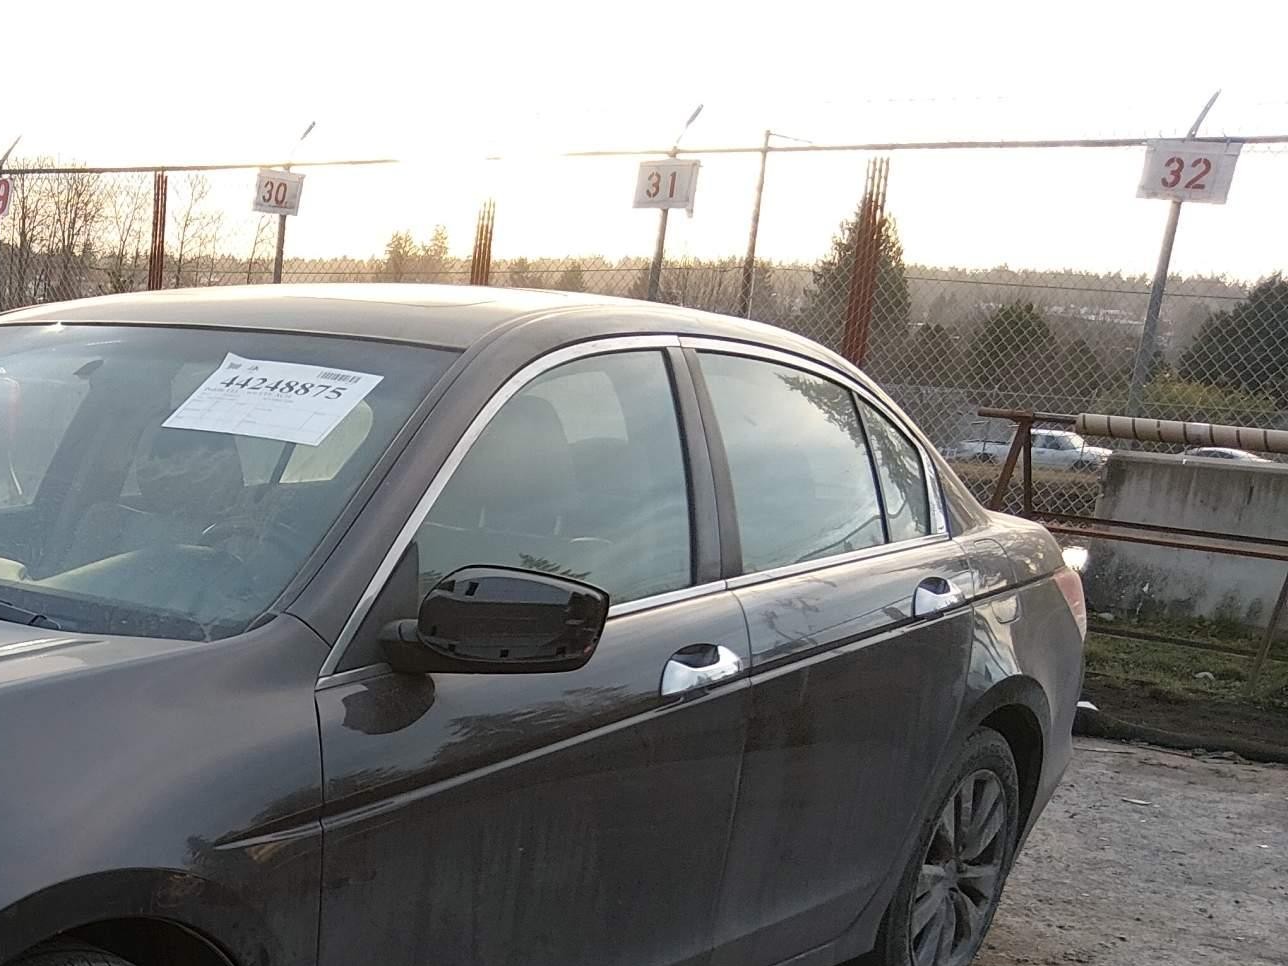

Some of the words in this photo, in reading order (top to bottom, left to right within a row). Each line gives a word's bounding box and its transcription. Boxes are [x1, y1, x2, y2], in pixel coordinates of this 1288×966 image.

[645, 171, 678, 199] 31
[1160, 156, 1212, 190] 32
[261, 180, 288, 206] 30
[220, 375, 349, 400] 44248875
